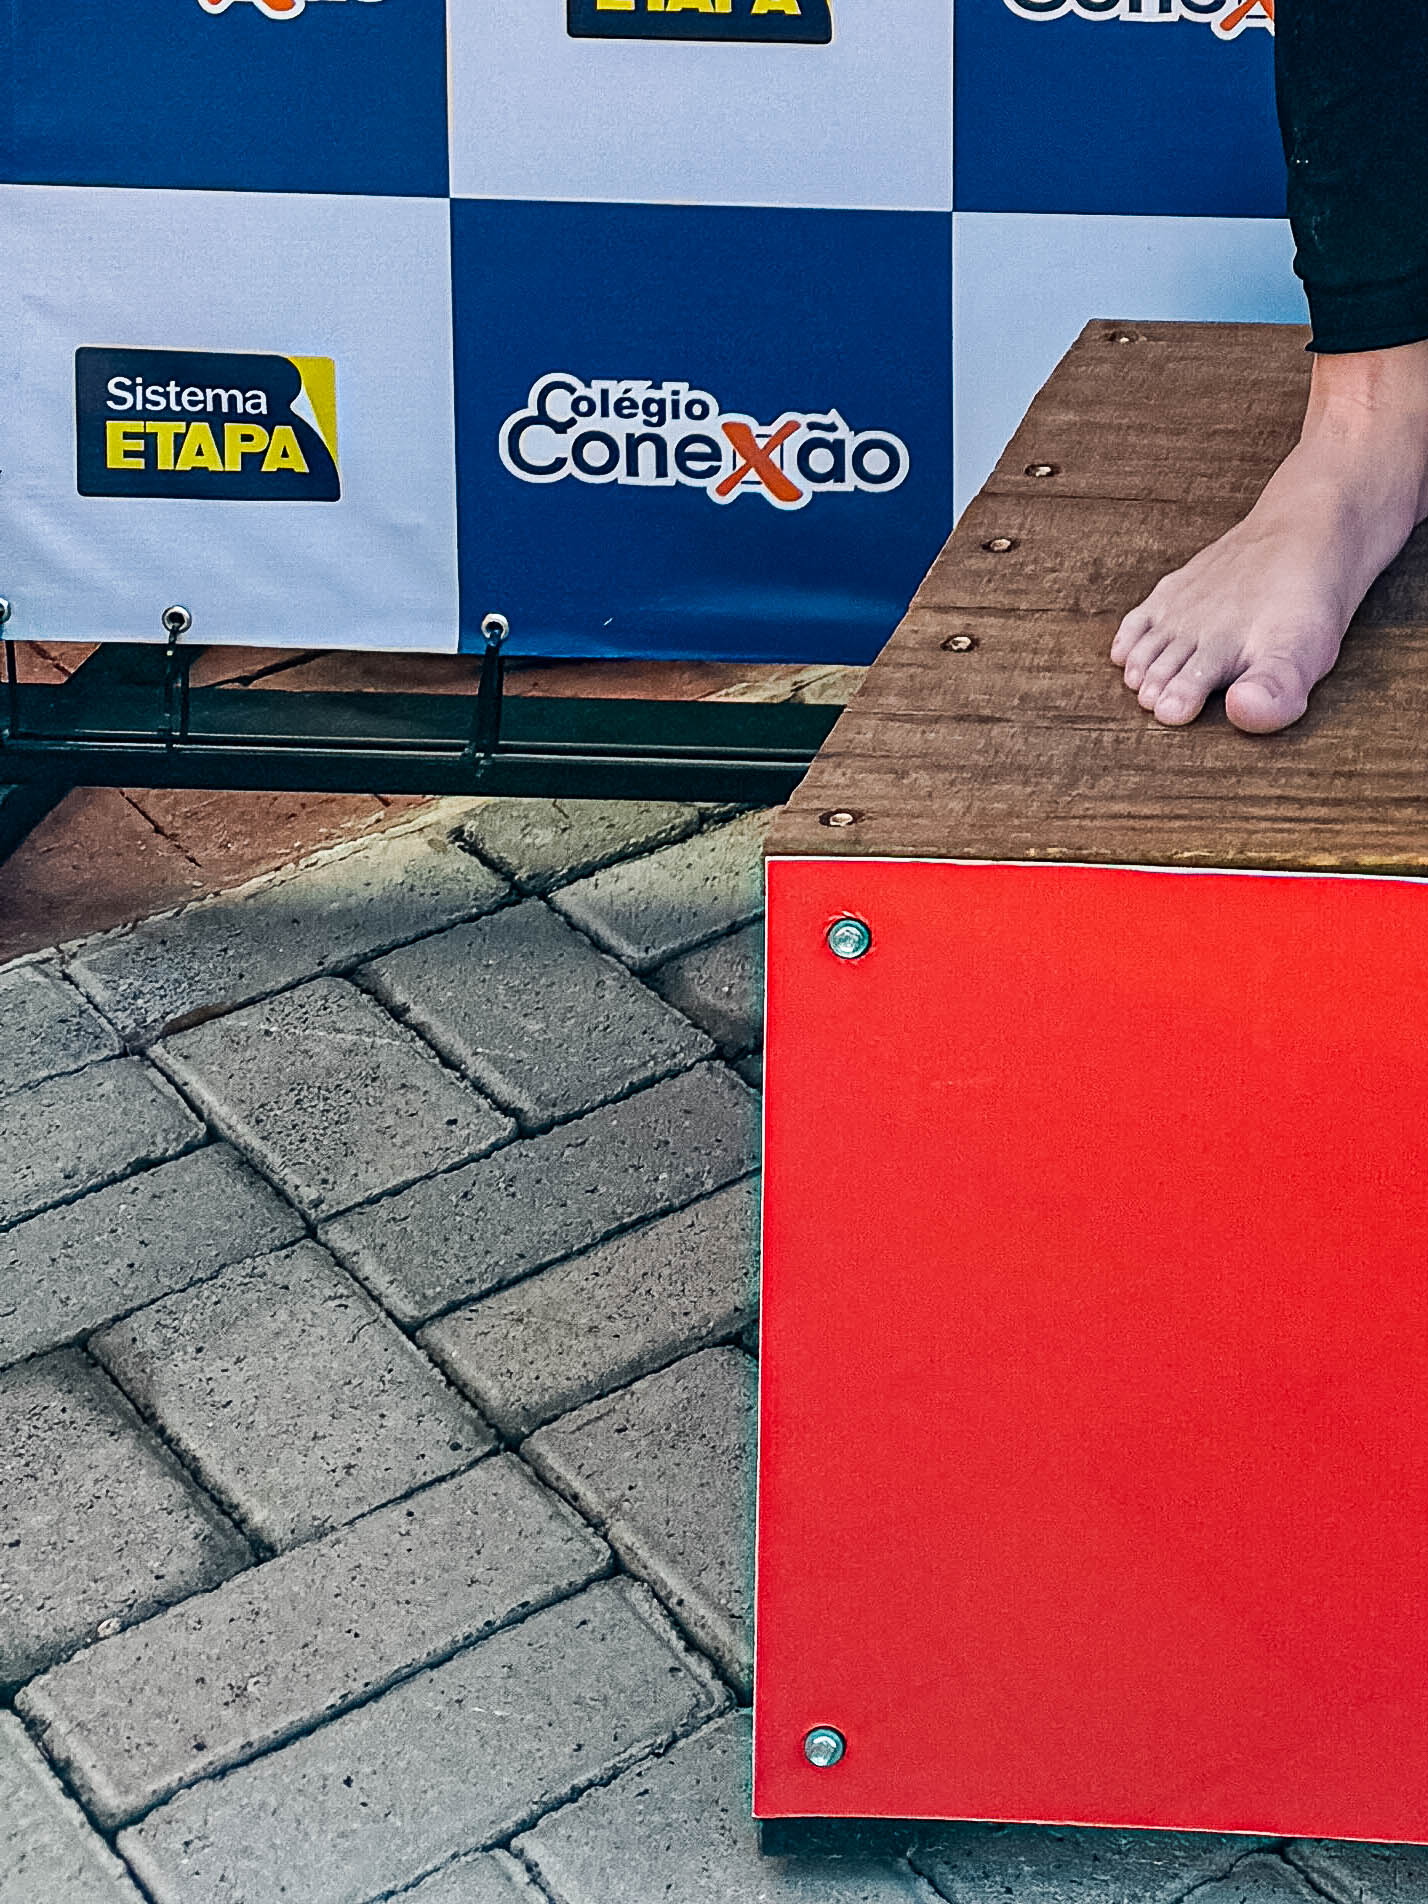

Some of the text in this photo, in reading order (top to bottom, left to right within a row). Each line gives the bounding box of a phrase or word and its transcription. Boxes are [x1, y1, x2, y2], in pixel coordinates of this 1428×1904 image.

[106, 376, 268, 414] Sistema
[536, 380, 710, 428] Colégio
[106, 419, 309, 474] ETAPA
